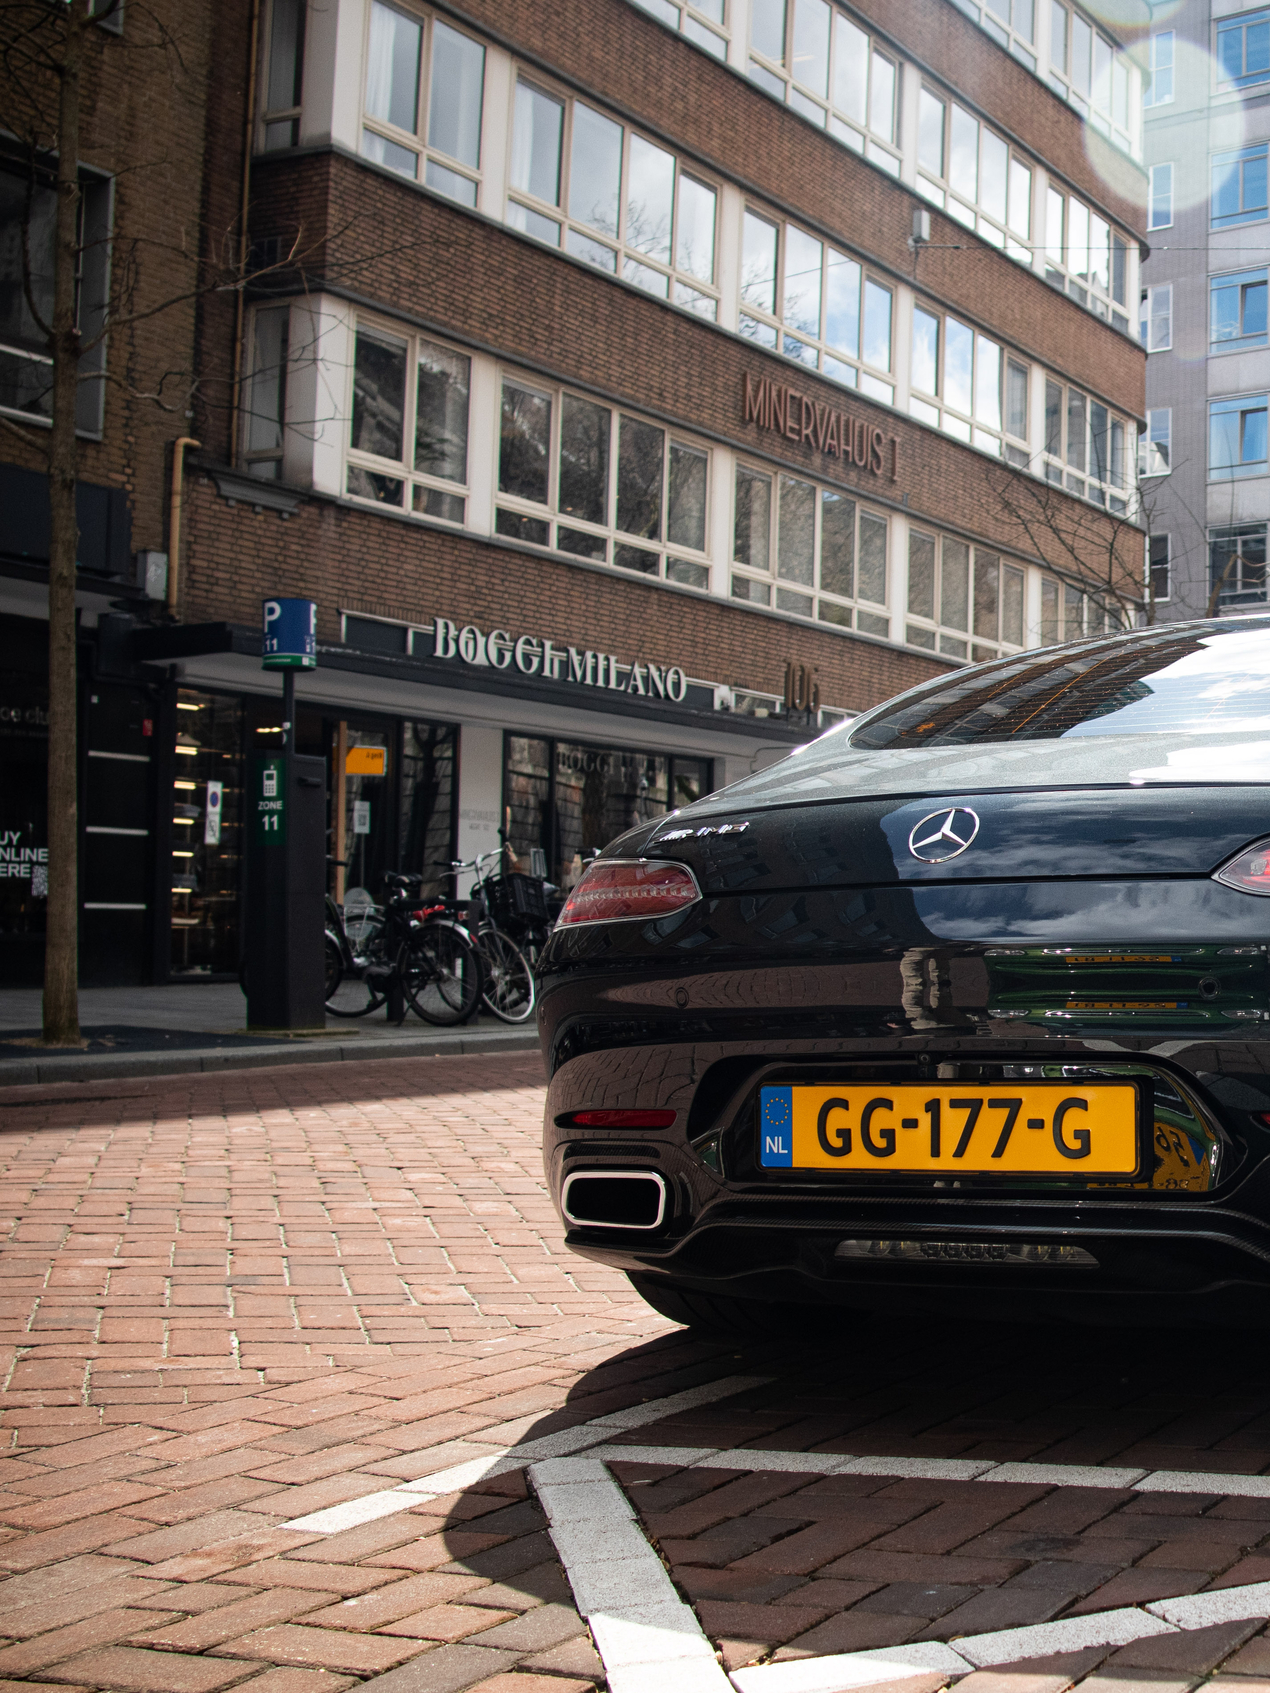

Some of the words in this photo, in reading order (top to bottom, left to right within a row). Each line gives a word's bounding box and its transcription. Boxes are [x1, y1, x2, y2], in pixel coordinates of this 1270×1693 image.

[743, 371, 885, 475] MINERVAHUIS
[264, 601, 281, 633] P
[433, 617, 554, 677] BOGGI
[566, 646, 687, 702] MILANO
[258, 801, 283, 810] ZONE
[262, 815, 279, 831] 11
[816, 1096, 1092, 1160] GG-177-G
[766, 1135, 789, 1154] NL
